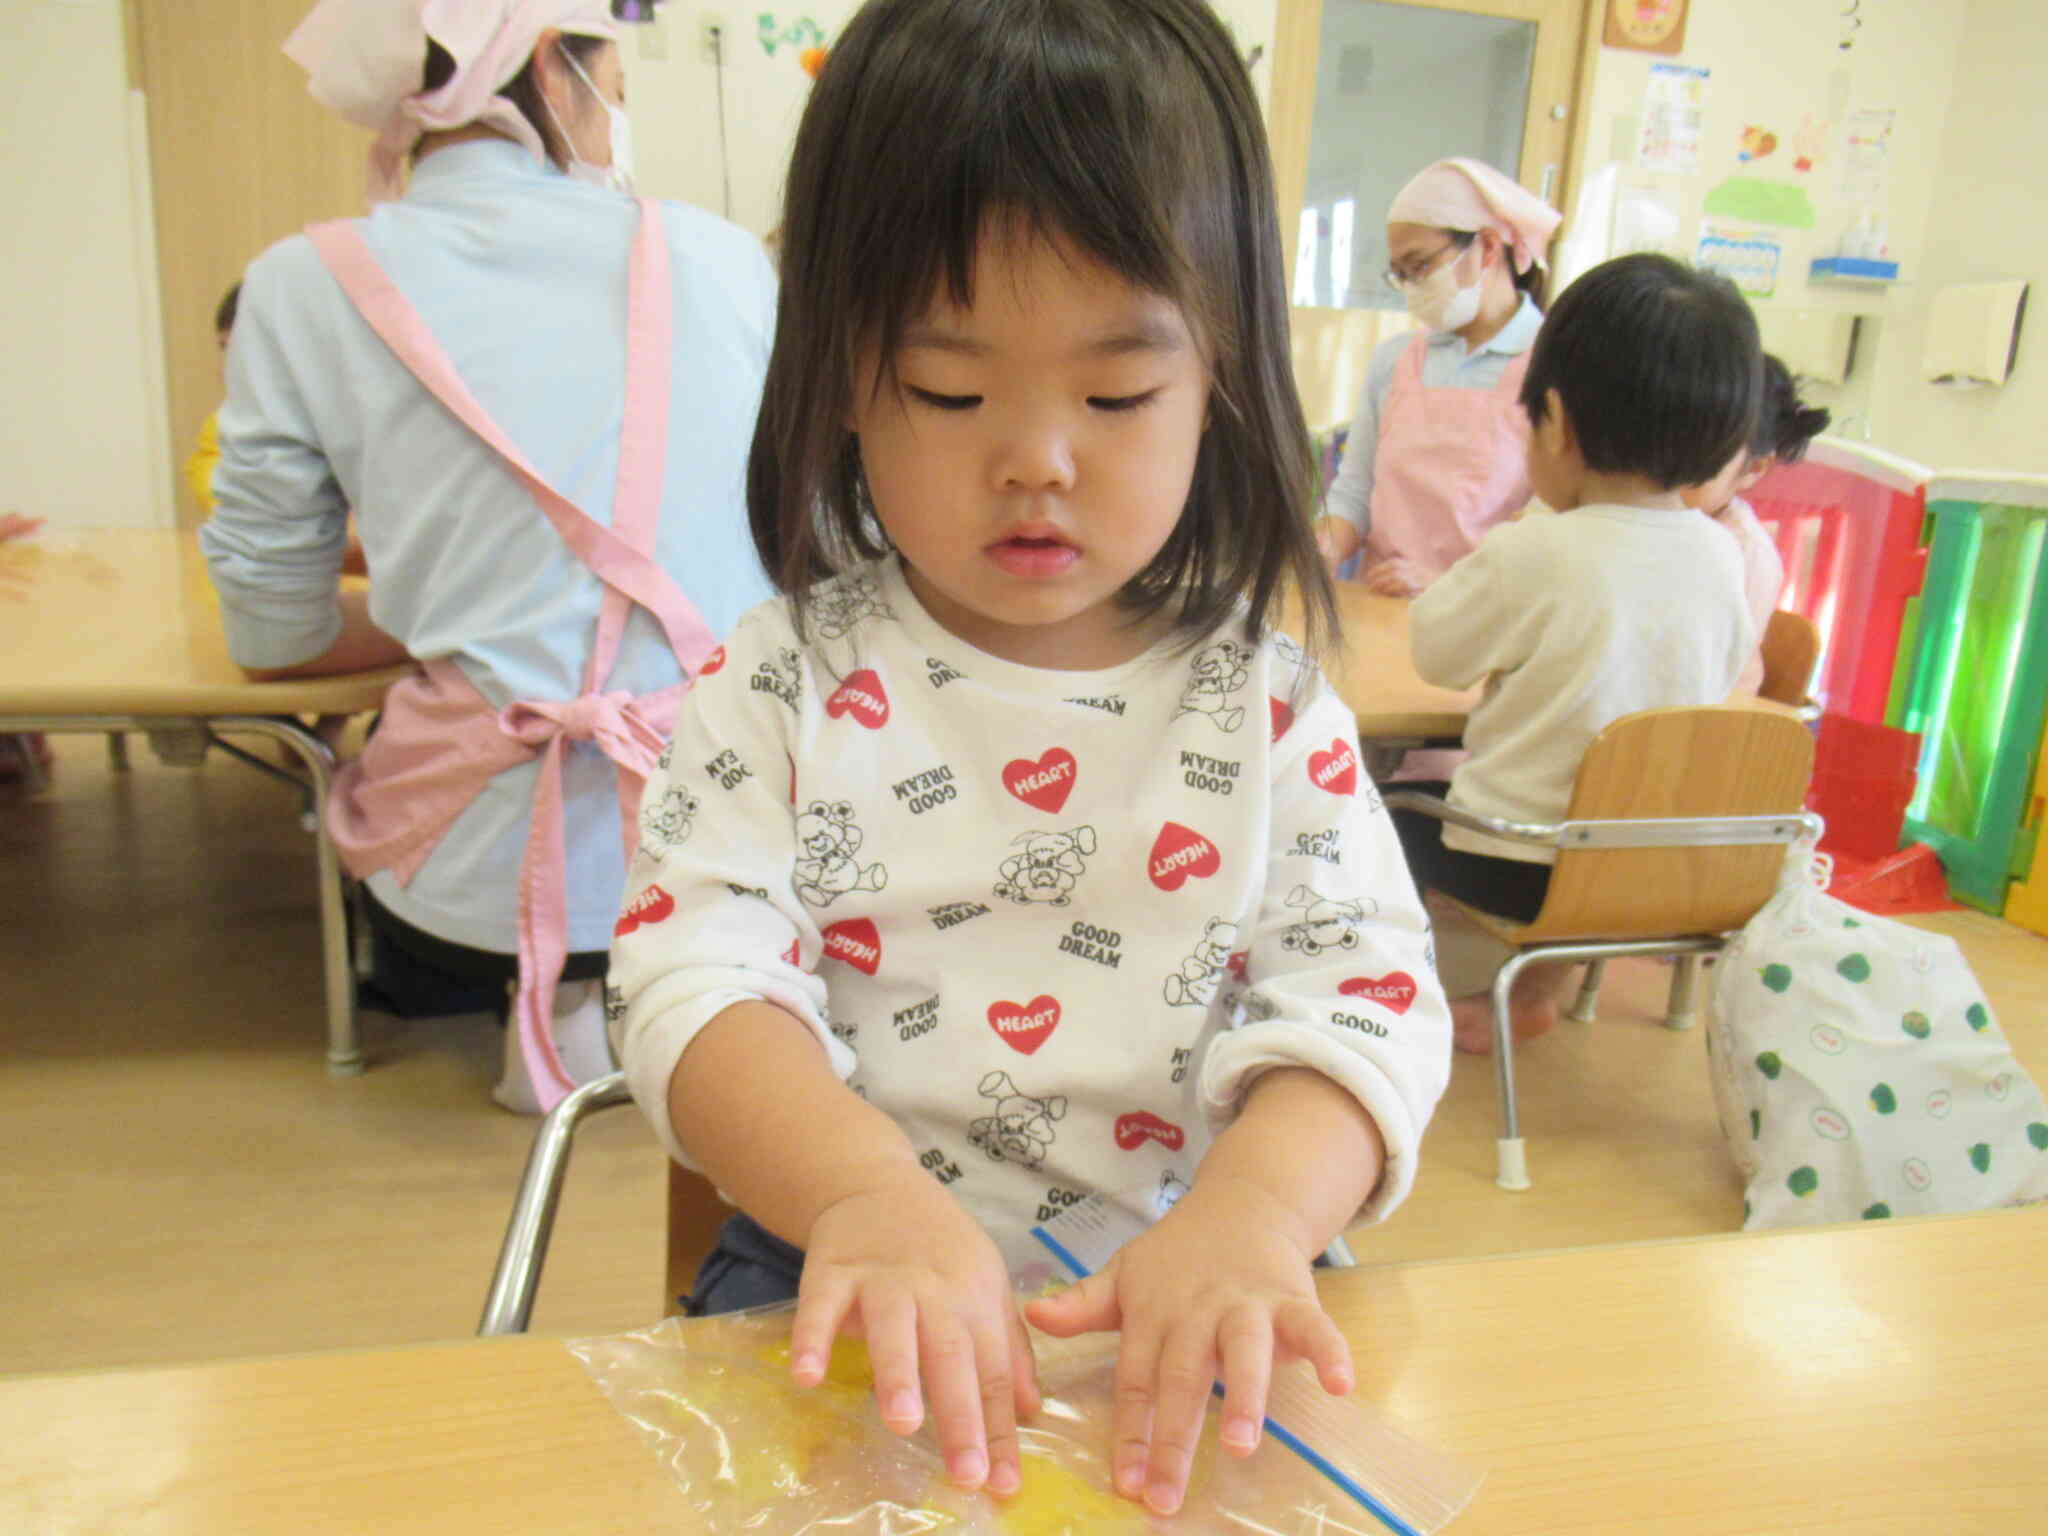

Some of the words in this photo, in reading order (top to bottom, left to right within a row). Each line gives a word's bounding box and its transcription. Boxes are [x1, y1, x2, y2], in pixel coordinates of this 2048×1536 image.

[705, 748, 739, 779] EAM
[1013, 761, 1071, 796] HEART
[1181, 751, 1240, 777] DREAM
[892, 764, 954, 800] DREAM
[1184, 770, 1234, 796] GOOD
[908, 783, 957, 815] GOOD
[1153, 838, 1211, 878] HEART
[931, 903, 993, 931] DREAM
[1071, 921, 1122, 949] GOOD
[1057, 934, 1123, 969] DREAM
[899, 1013, 939, 1042] GOOD
[996, 1008, 1057, 1033] HEART
